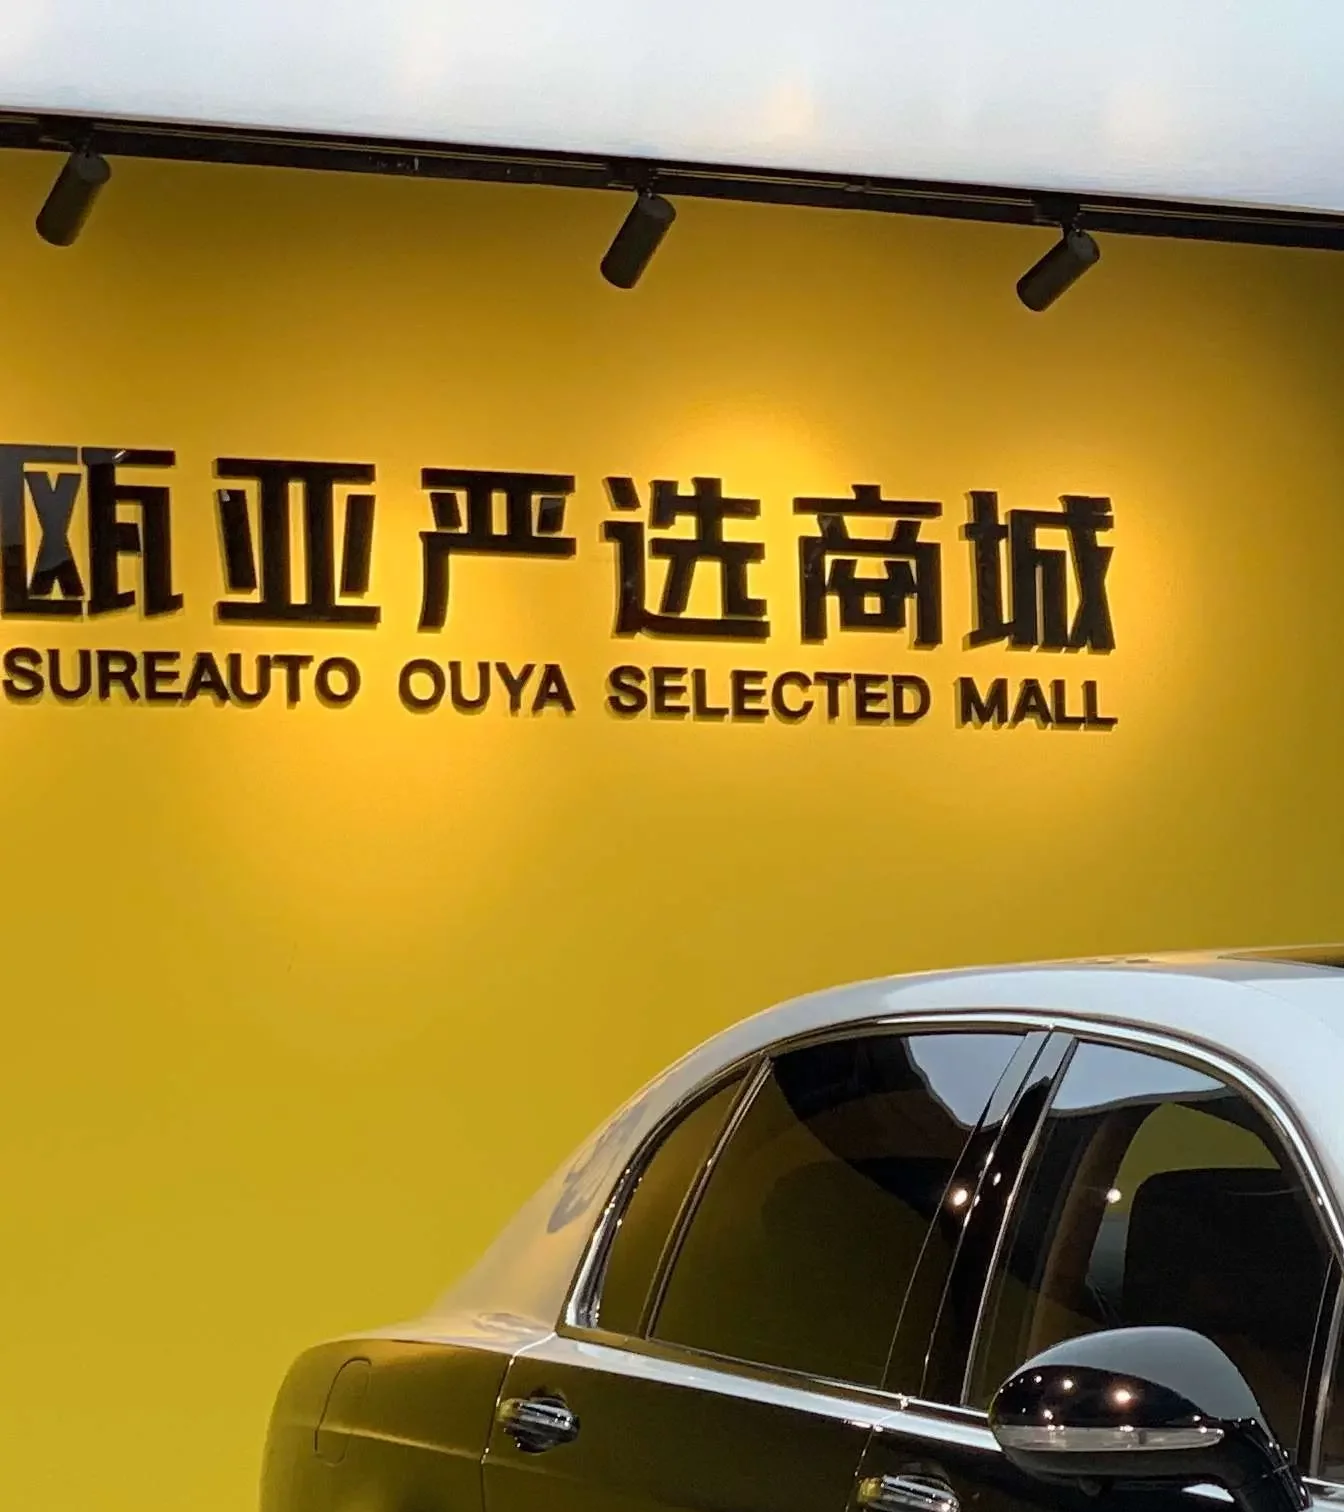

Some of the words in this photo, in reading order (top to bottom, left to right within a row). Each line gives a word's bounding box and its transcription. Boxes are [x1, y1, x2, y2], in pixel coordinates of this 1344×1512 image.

[0, 443, 1117, 653] 瓯亚严选商城
[3, 647, 361, 709] SUREAUTO
[399, 658, 576, 713] OUYA
[605, 665, 932, 725] SELECTED
[958, 675, 1118, 728] MALL
